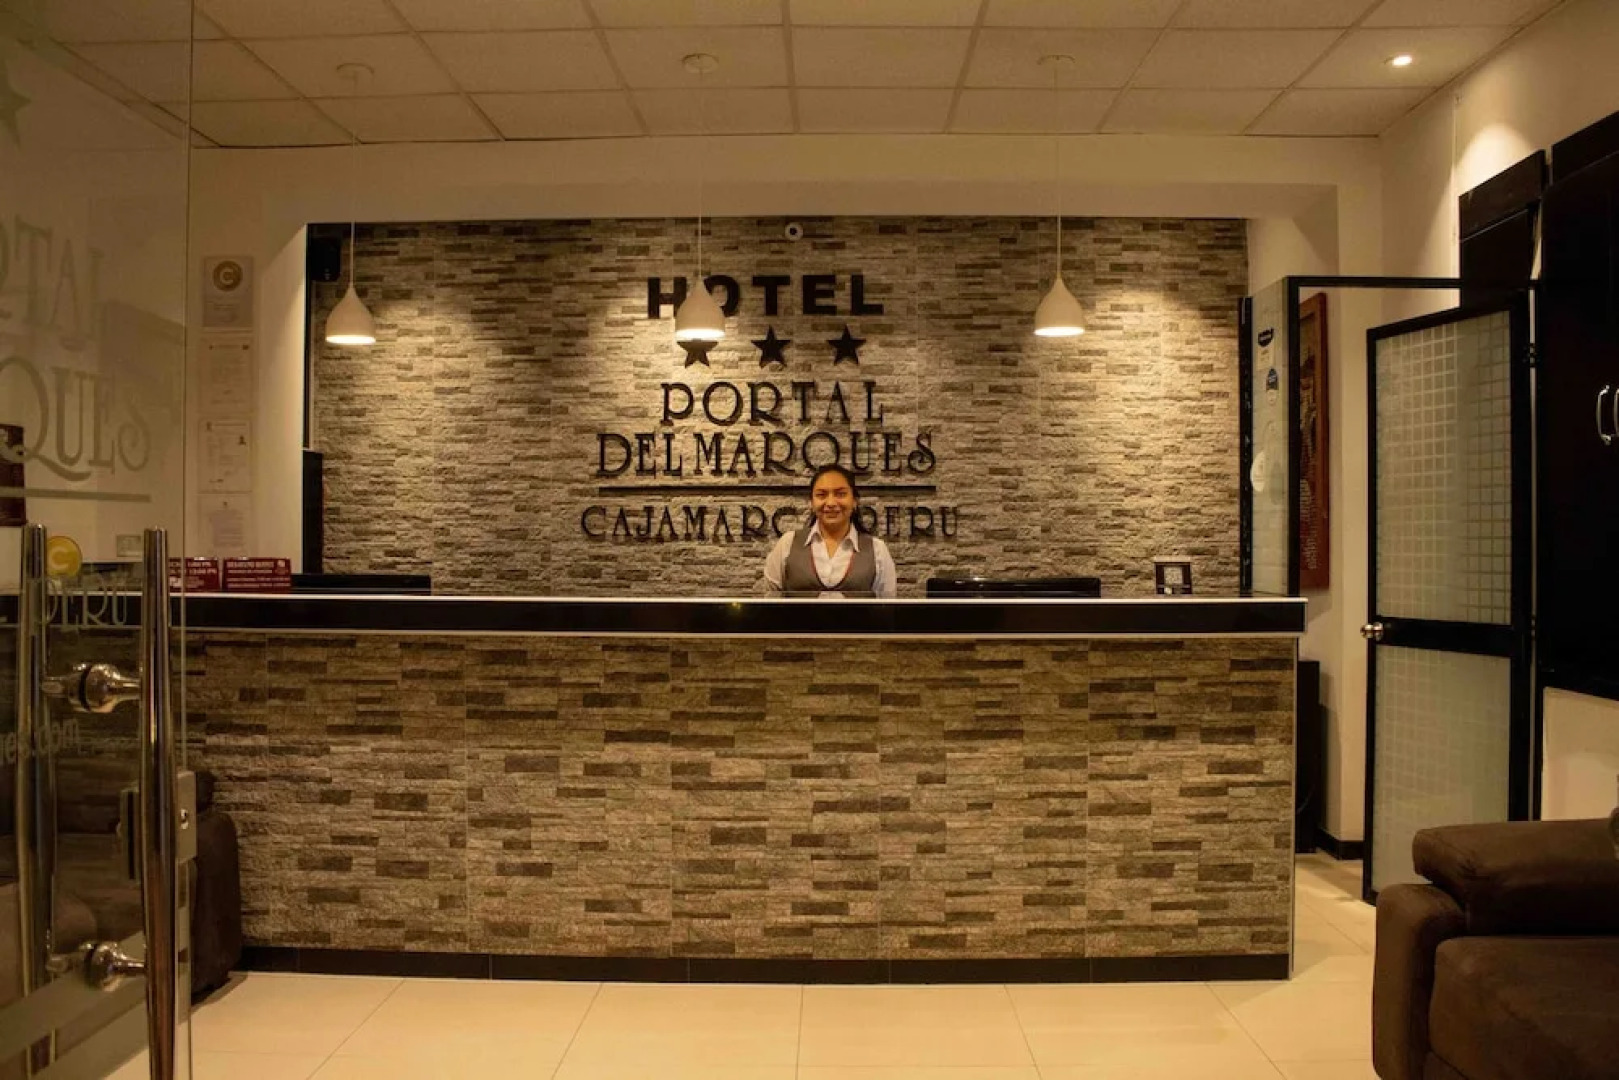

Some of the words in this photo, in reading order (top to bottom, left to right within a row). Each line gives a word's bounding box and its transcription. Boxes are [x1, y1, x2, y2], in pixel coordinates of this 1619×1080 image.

[647, 274, 885, 319] HOTEL
[660, 380, 885, 426] PORTAL
[596, 432, 683, 478] DEL
[694, 431, 937, 478] MARQUES
[580, 505, 798, 543] CAJAMARC
